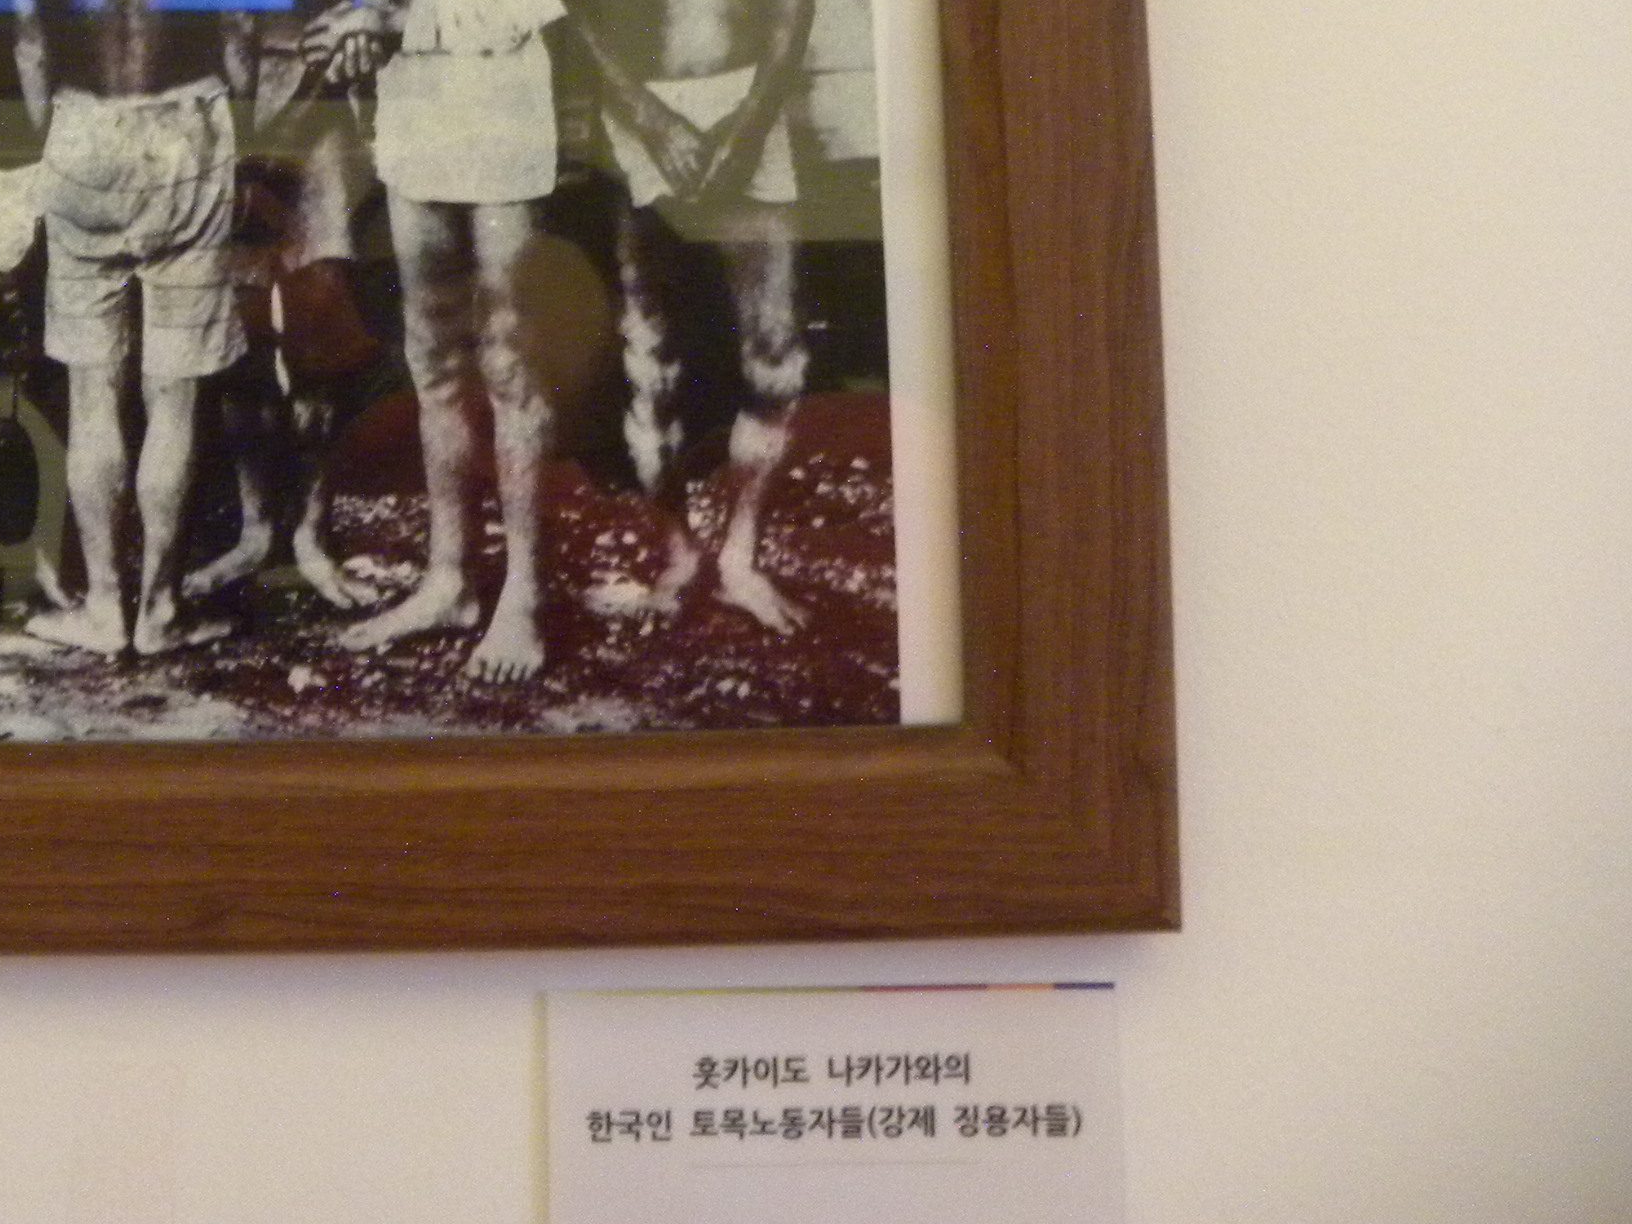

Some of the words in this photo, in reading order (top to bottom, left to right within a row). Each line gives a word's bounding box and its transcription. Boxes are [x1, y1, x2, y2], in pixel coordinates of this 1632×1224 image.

[827, 1052, 971, 1087] 나카가와의
[585, 1109, 672, 1143] 한국인
[689, 1105, 936, 1141] 토목노동자들(강제
[953, 1104, 1083, 1138] 징용자들)
